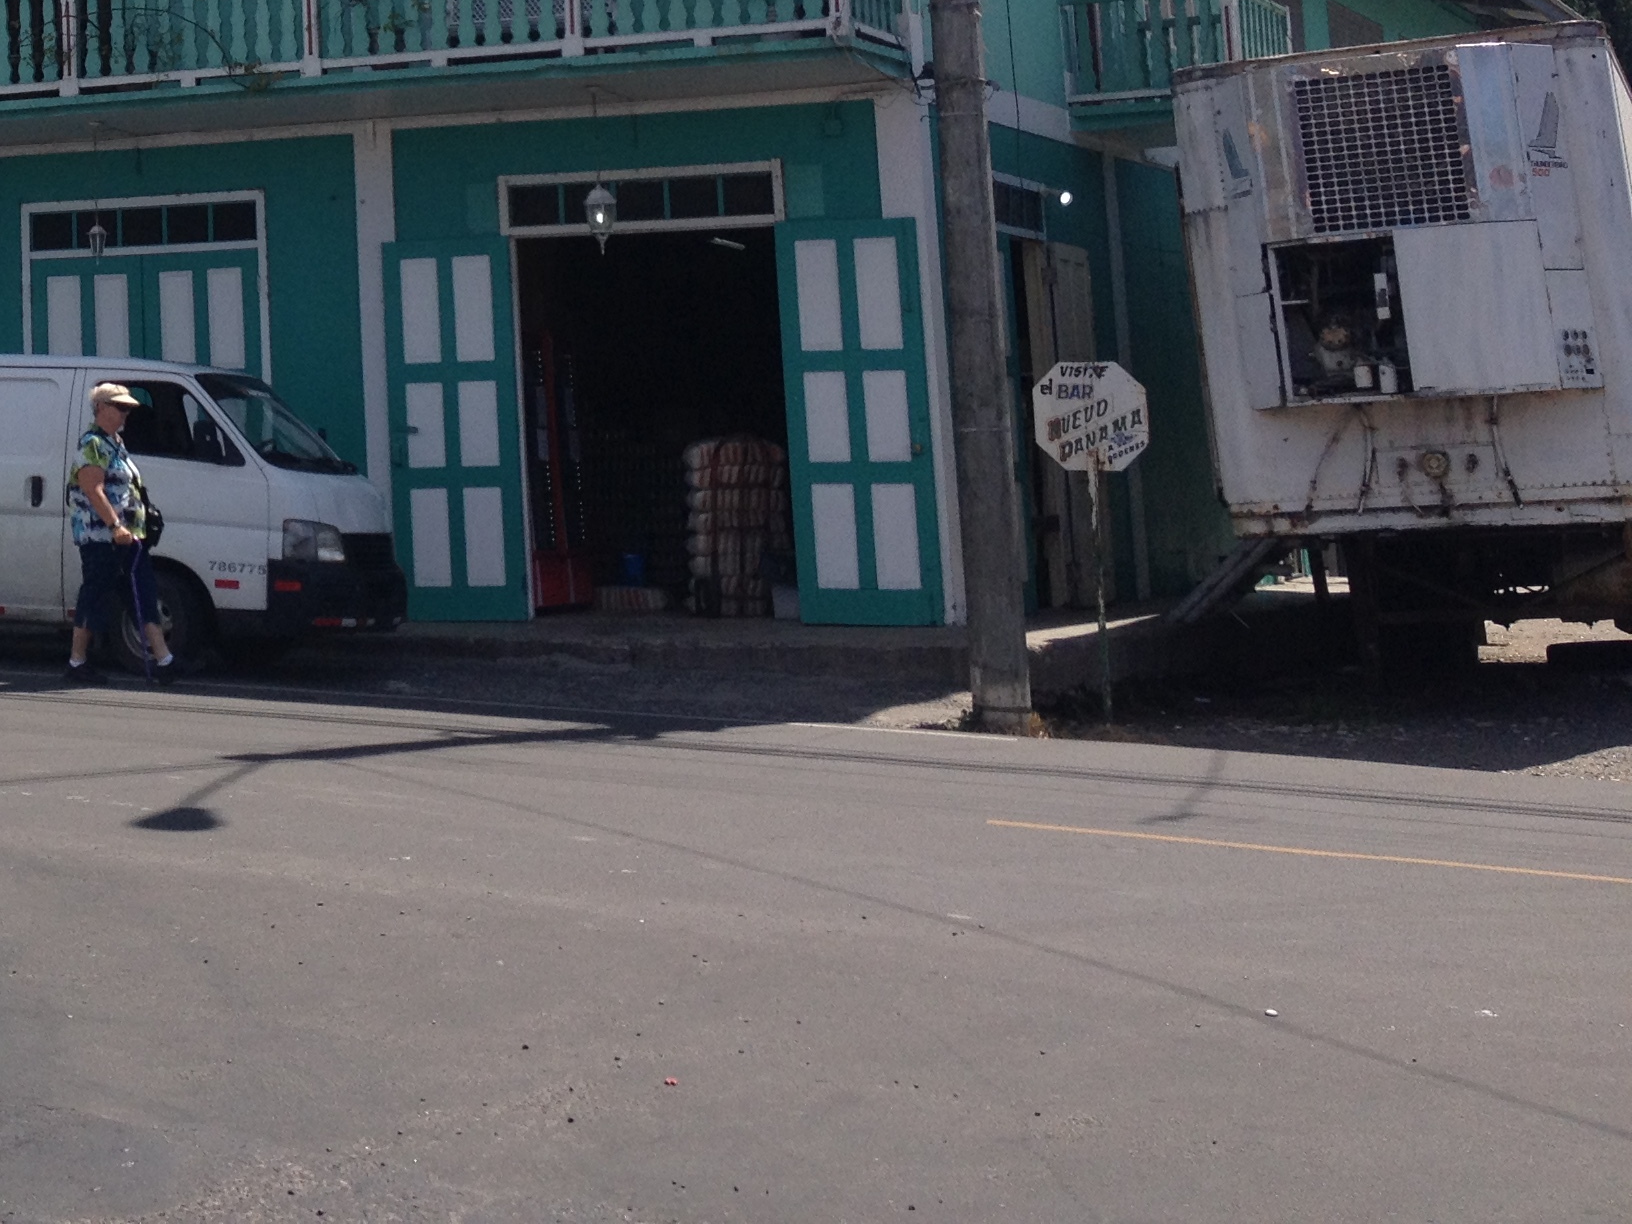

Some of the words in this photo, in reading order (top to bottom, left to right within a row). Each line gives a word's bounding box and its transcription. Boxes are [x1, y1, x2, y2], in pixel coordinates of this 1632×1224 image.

[1057, 383, 1093, 399] BAR
[1059, 408, 1142, 461] PANAMA
[208, 560, 267, 575] 786775
